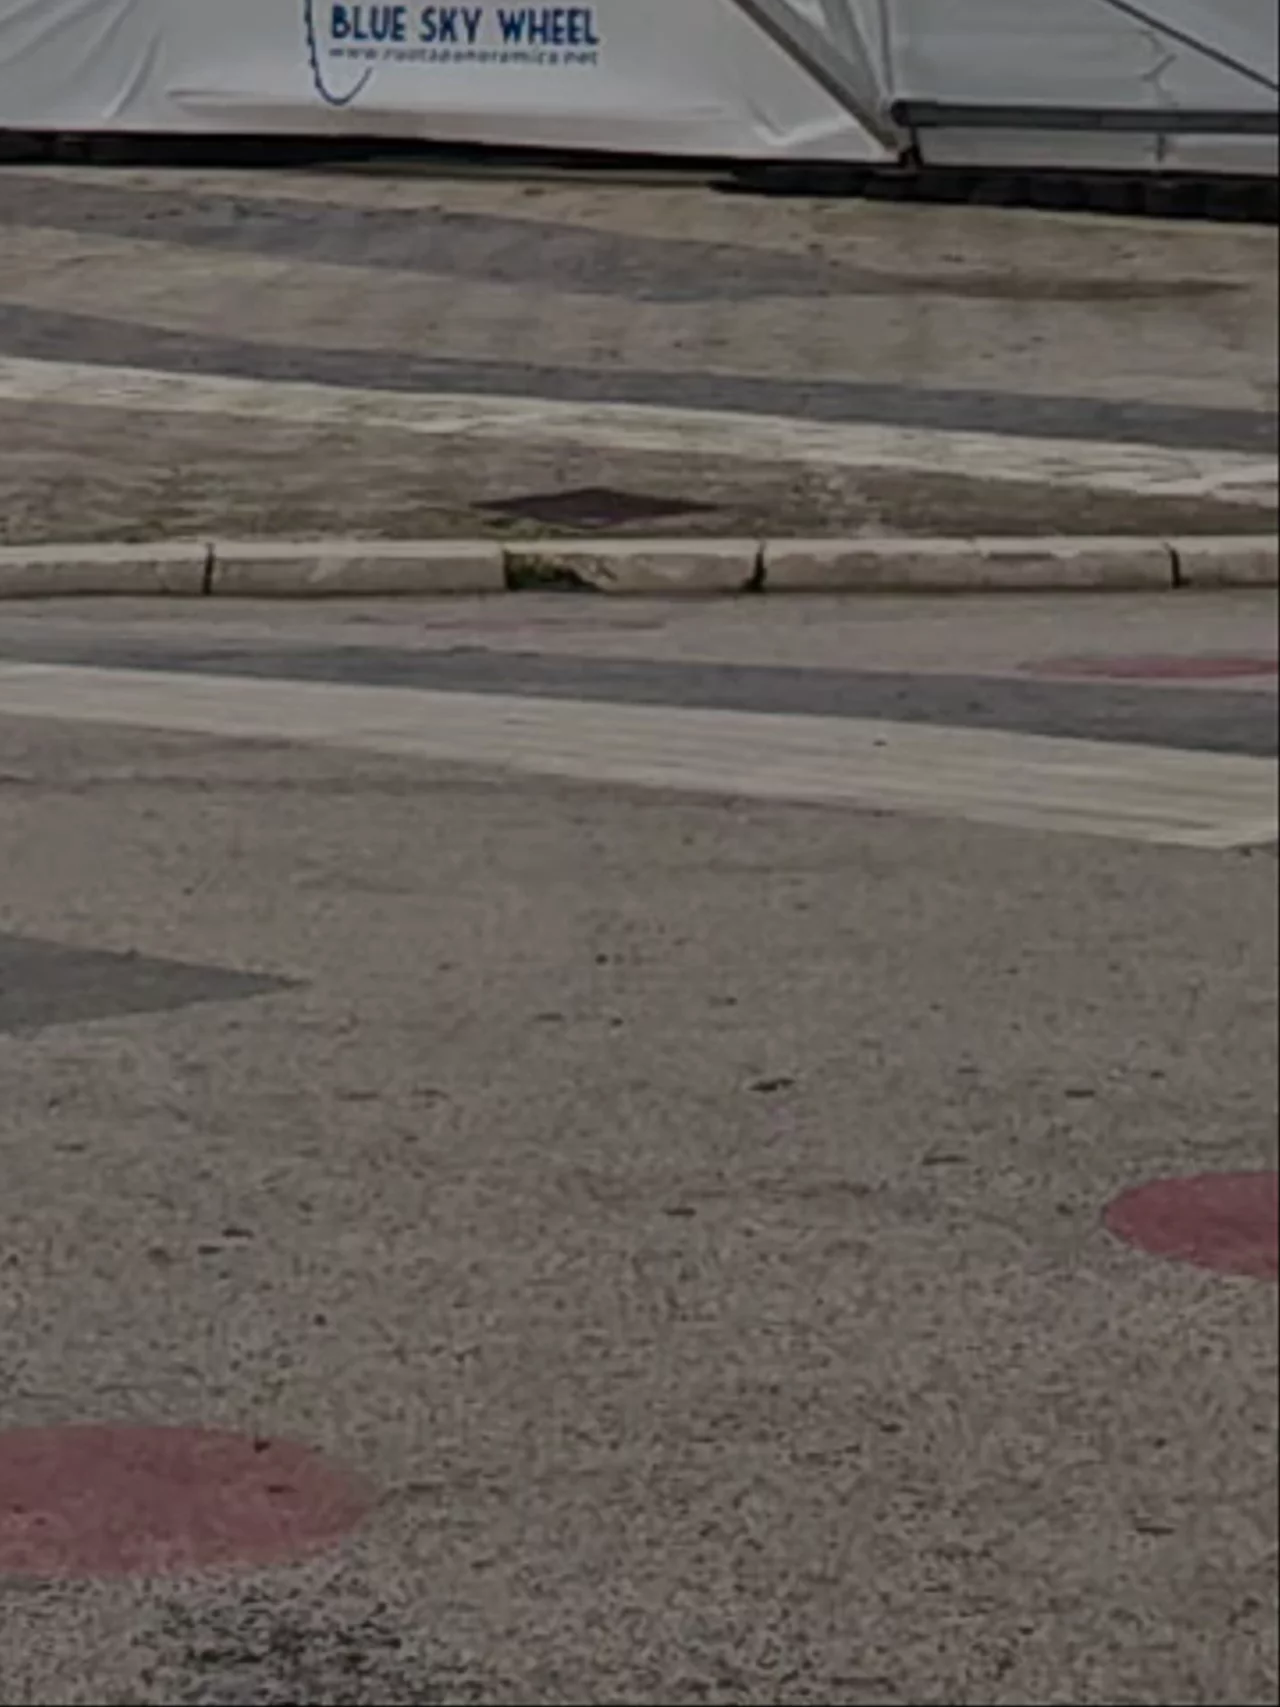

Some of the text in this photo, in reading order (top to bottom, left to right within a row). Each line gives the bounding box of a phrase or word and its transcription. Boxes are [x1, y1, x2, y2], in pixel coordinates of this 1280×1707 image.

[330, 4, 601, 46] BLUE SKY WHEEL
